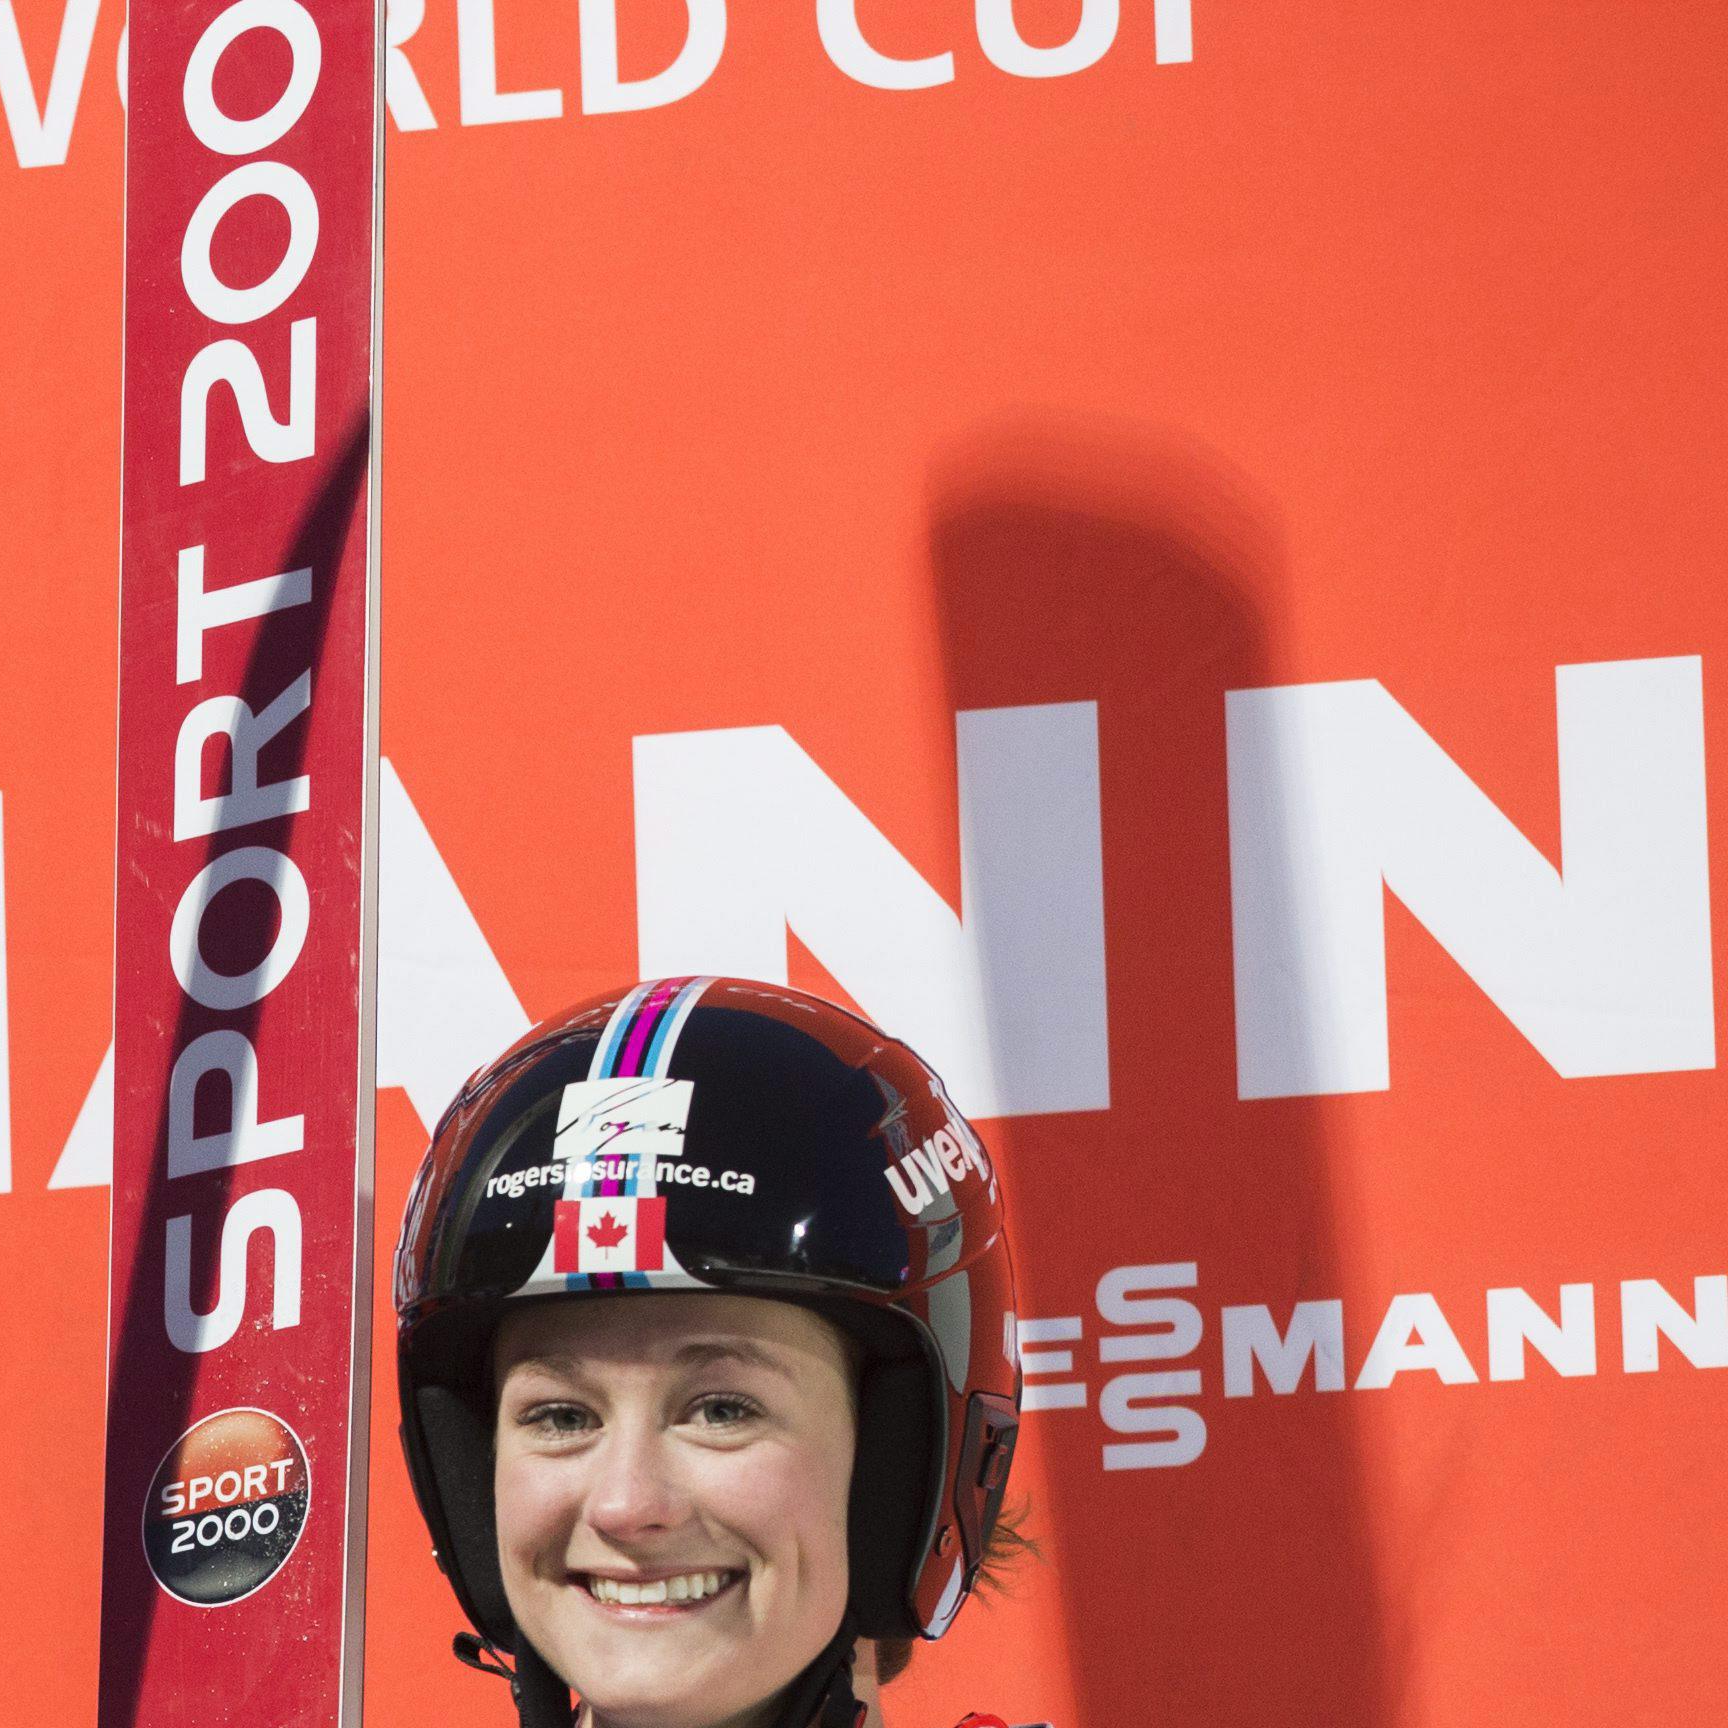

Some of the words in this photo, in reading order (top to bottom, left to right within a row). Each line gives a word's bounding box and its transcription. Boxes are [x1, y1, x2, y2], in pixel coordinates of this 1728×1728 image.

[164, 545, 315, 1354] SPORT
[486, 1157, 755, 1198] rogersinsurance.ca
[1020, 1262, 1728, 1471] ESSMANN
[161, 1458, 294, 1515] SPORT
[171, 1504, 279, 1553] 2000
